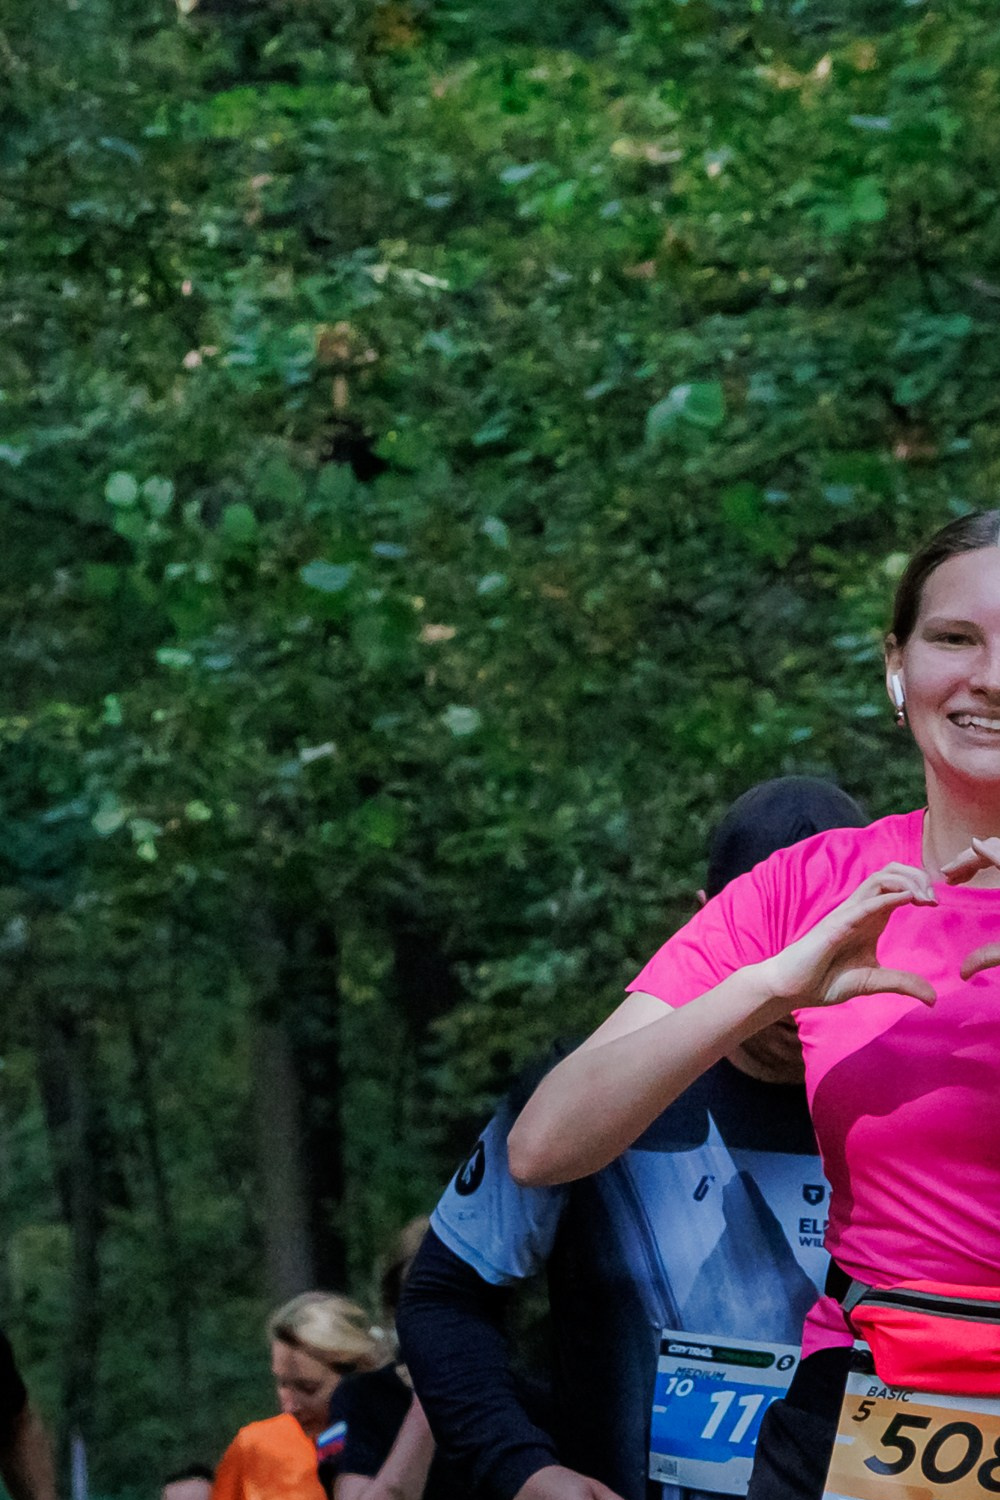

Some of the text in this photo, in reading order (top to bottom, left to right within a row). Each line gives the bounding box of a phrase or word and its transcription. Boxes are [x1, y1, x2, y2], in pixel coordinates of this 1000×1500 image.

[674, 1366, 726, 1382] MEDIUM
[665, 1377, 694, 1397] 10
[866, 1385, 914, 1403] BASIC
[700, 1390, 776, 1445] 11
[851, 1400, 876, 1423] 5
